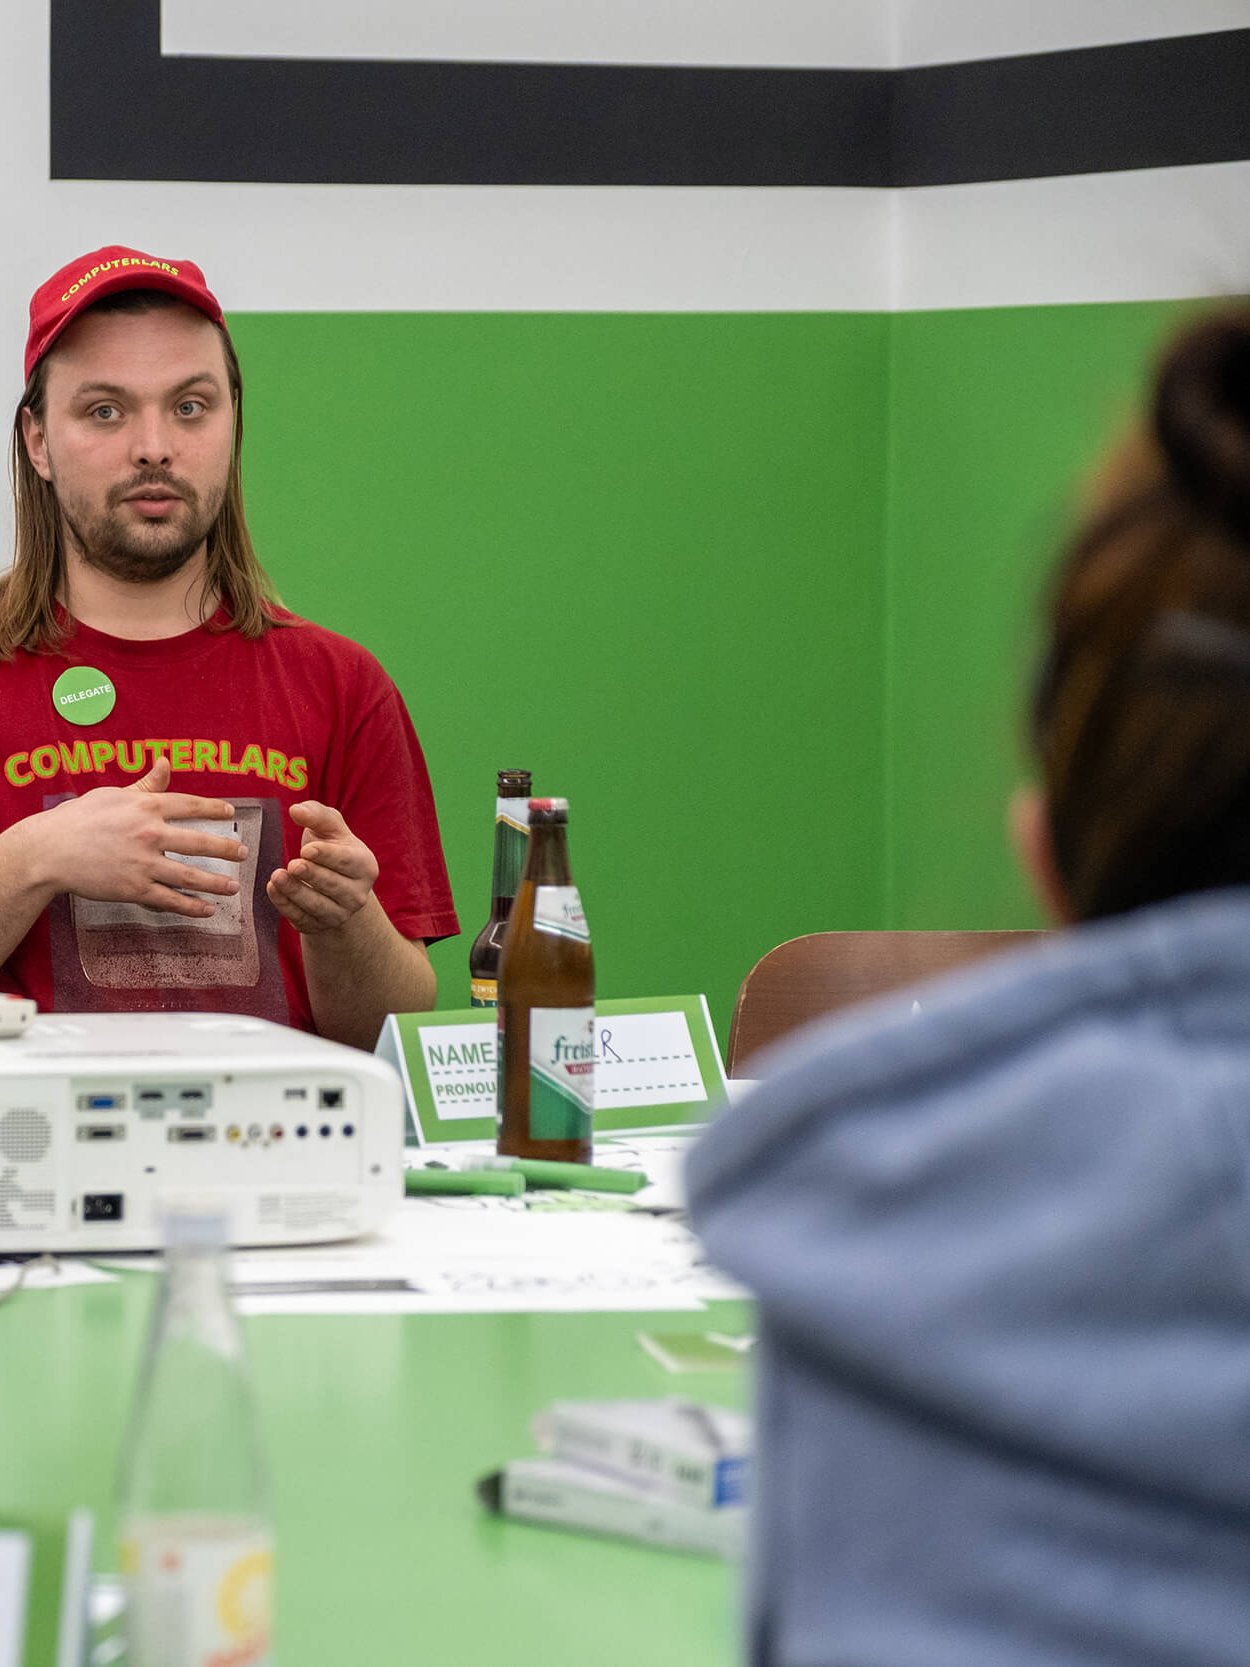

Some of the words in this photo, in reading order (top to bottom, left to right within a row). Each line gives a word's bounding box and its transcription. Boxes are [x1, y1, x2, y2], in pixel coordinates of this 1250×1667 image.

[61, 257, 180, 302] COMPUTERLARS
[59, 684, 112, 706] DELEGATE
[4, 738, 308, 790] COMPUTERLARS
[428, 1042, 497, 1067] NAME
